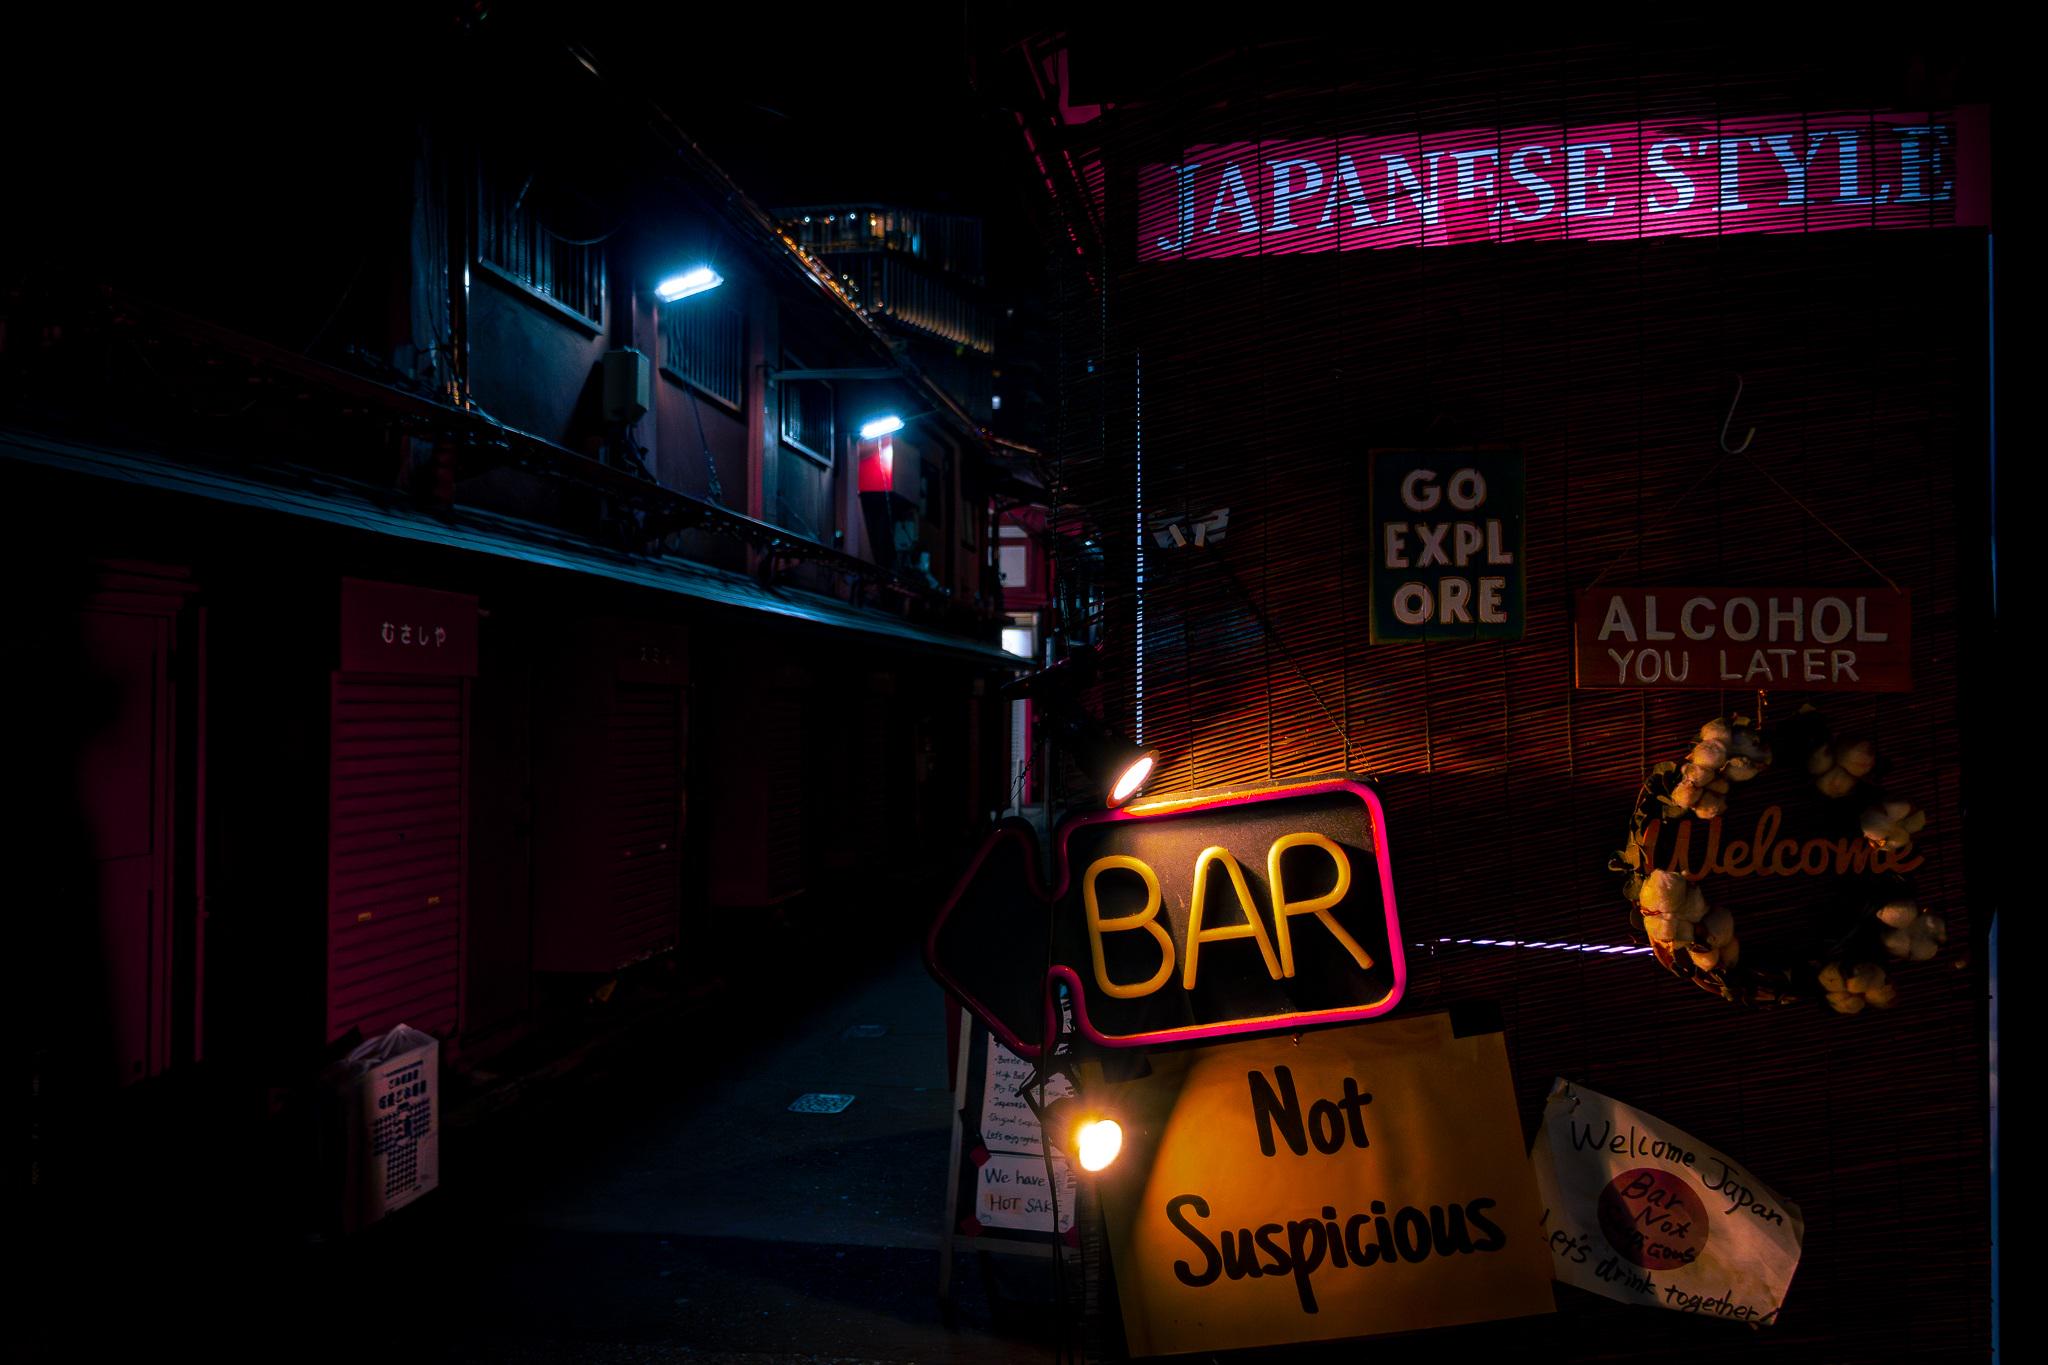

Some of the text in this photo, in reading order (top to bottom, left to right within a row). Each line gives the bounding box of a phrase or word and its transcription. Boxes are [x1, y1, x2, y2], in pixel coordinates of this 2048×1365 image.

[1157, 124, 1954, 252] JAPANESE STYLE
[1400, 467, 1488, 512] GO
[1383, 518, 1514, 569] EXPL
[1391, 576, 1508, 625] ORE
[1597, 594, 1889, 643] ALCOHOL
[380, 620, 447, 648] むさしや
[1608, 647, 1860, 684] YOU LATER
[1645, 804, 1926, 881] Welcome
[1083, 832, 1375, 999] BAR
[1247, 1066, 1372, 1157] Not
[985, 1168, 1045, 1187] We have
[1571, 1120, 1784, 1227] Welcome Japan
[1620, 1171, 1683, 1211] Bar
[1634, 1205, 1693, 1239] Not
[1166, 1194, 1506, 1313] Suspicious
[1595, 1255, 1656, 1296] drink
